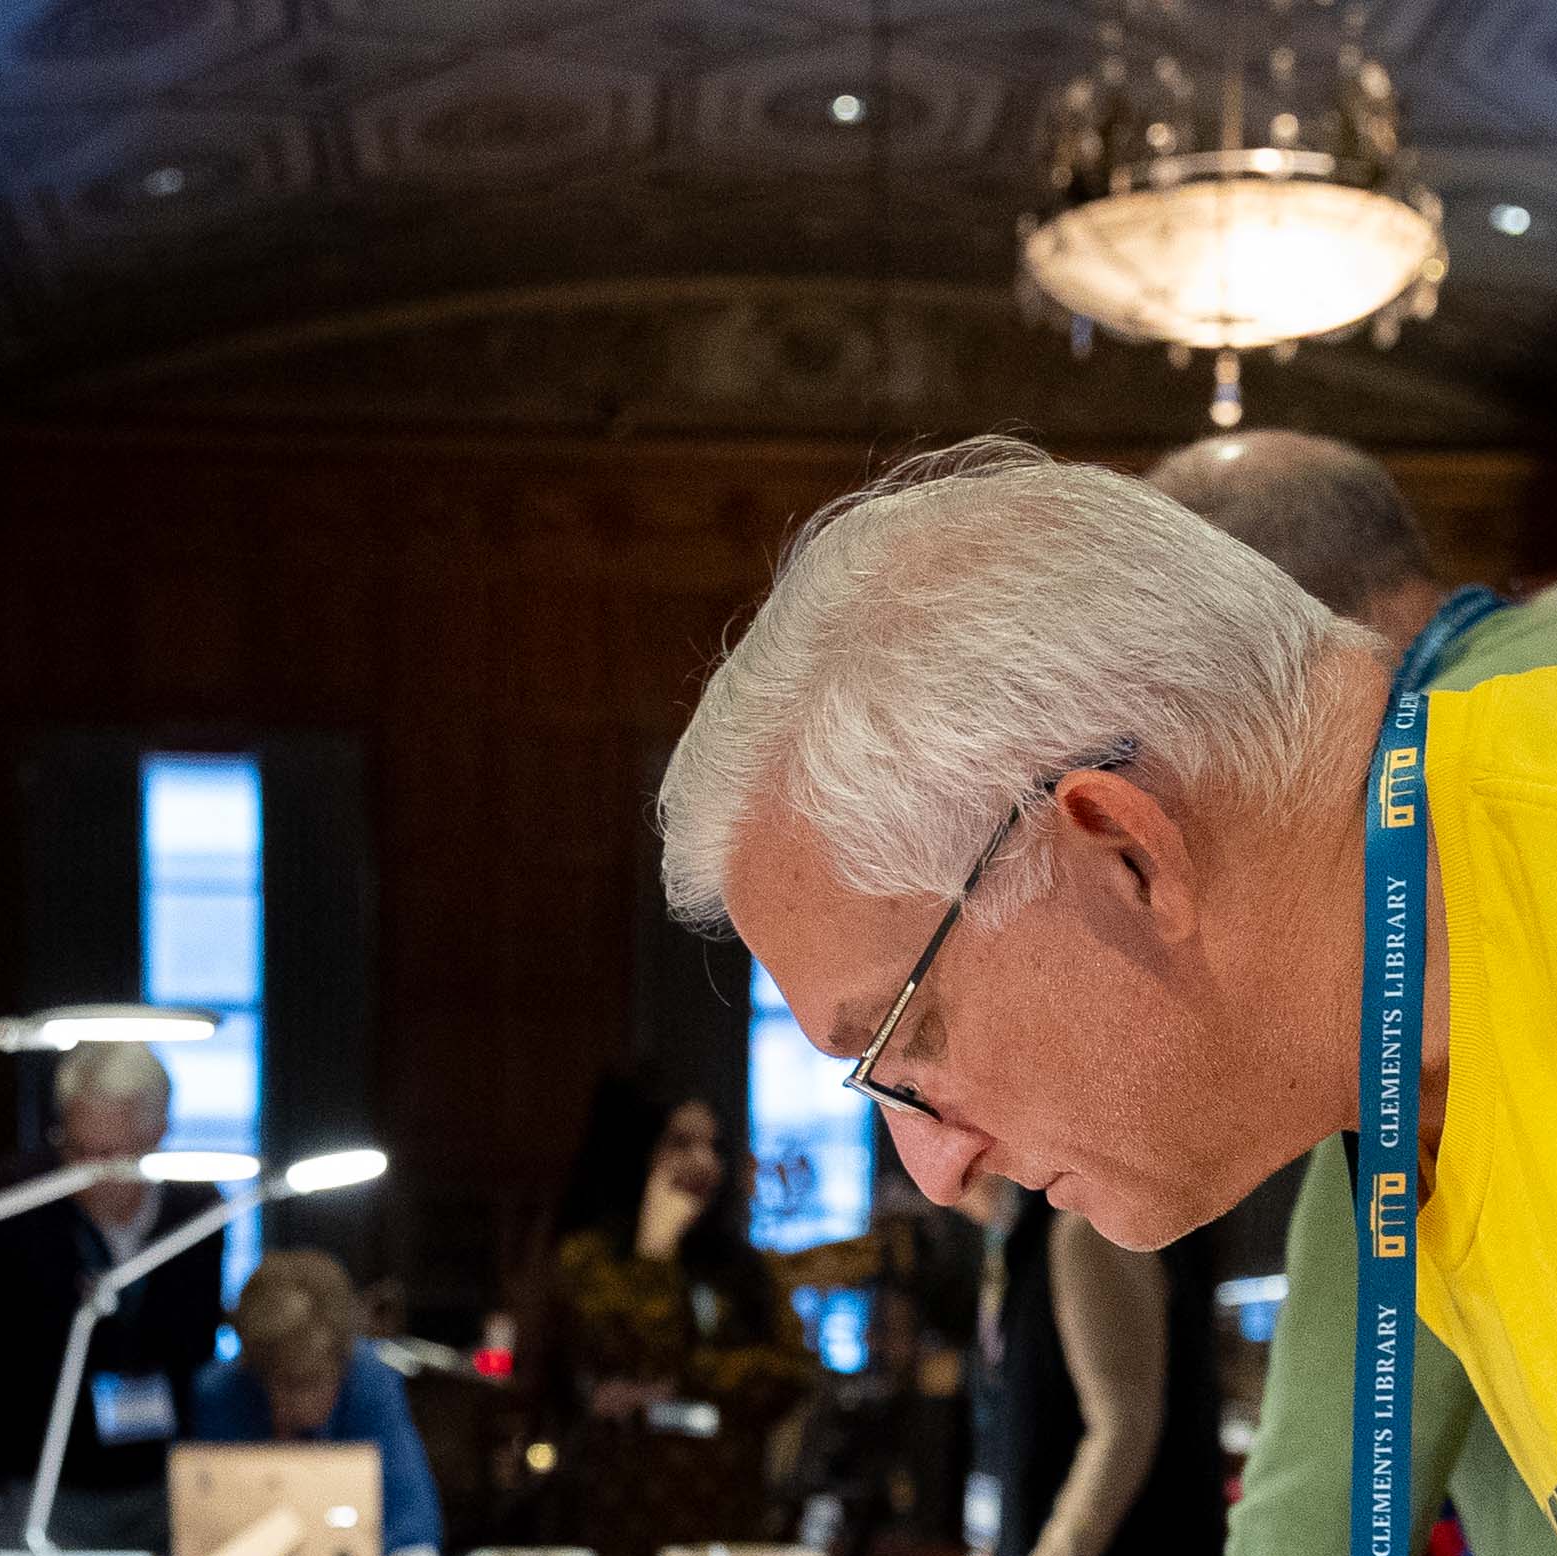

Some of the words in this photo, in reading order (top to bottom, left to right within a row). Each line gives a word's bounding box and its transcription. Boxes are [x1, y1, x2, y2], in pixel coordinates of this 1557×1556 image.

[1384, 876, 1408, 998] LIBRARY
[1380, 1008, 1403, 1148] CLEMENTS
[1375, 1304, 1397, 1419] LIBRARY
